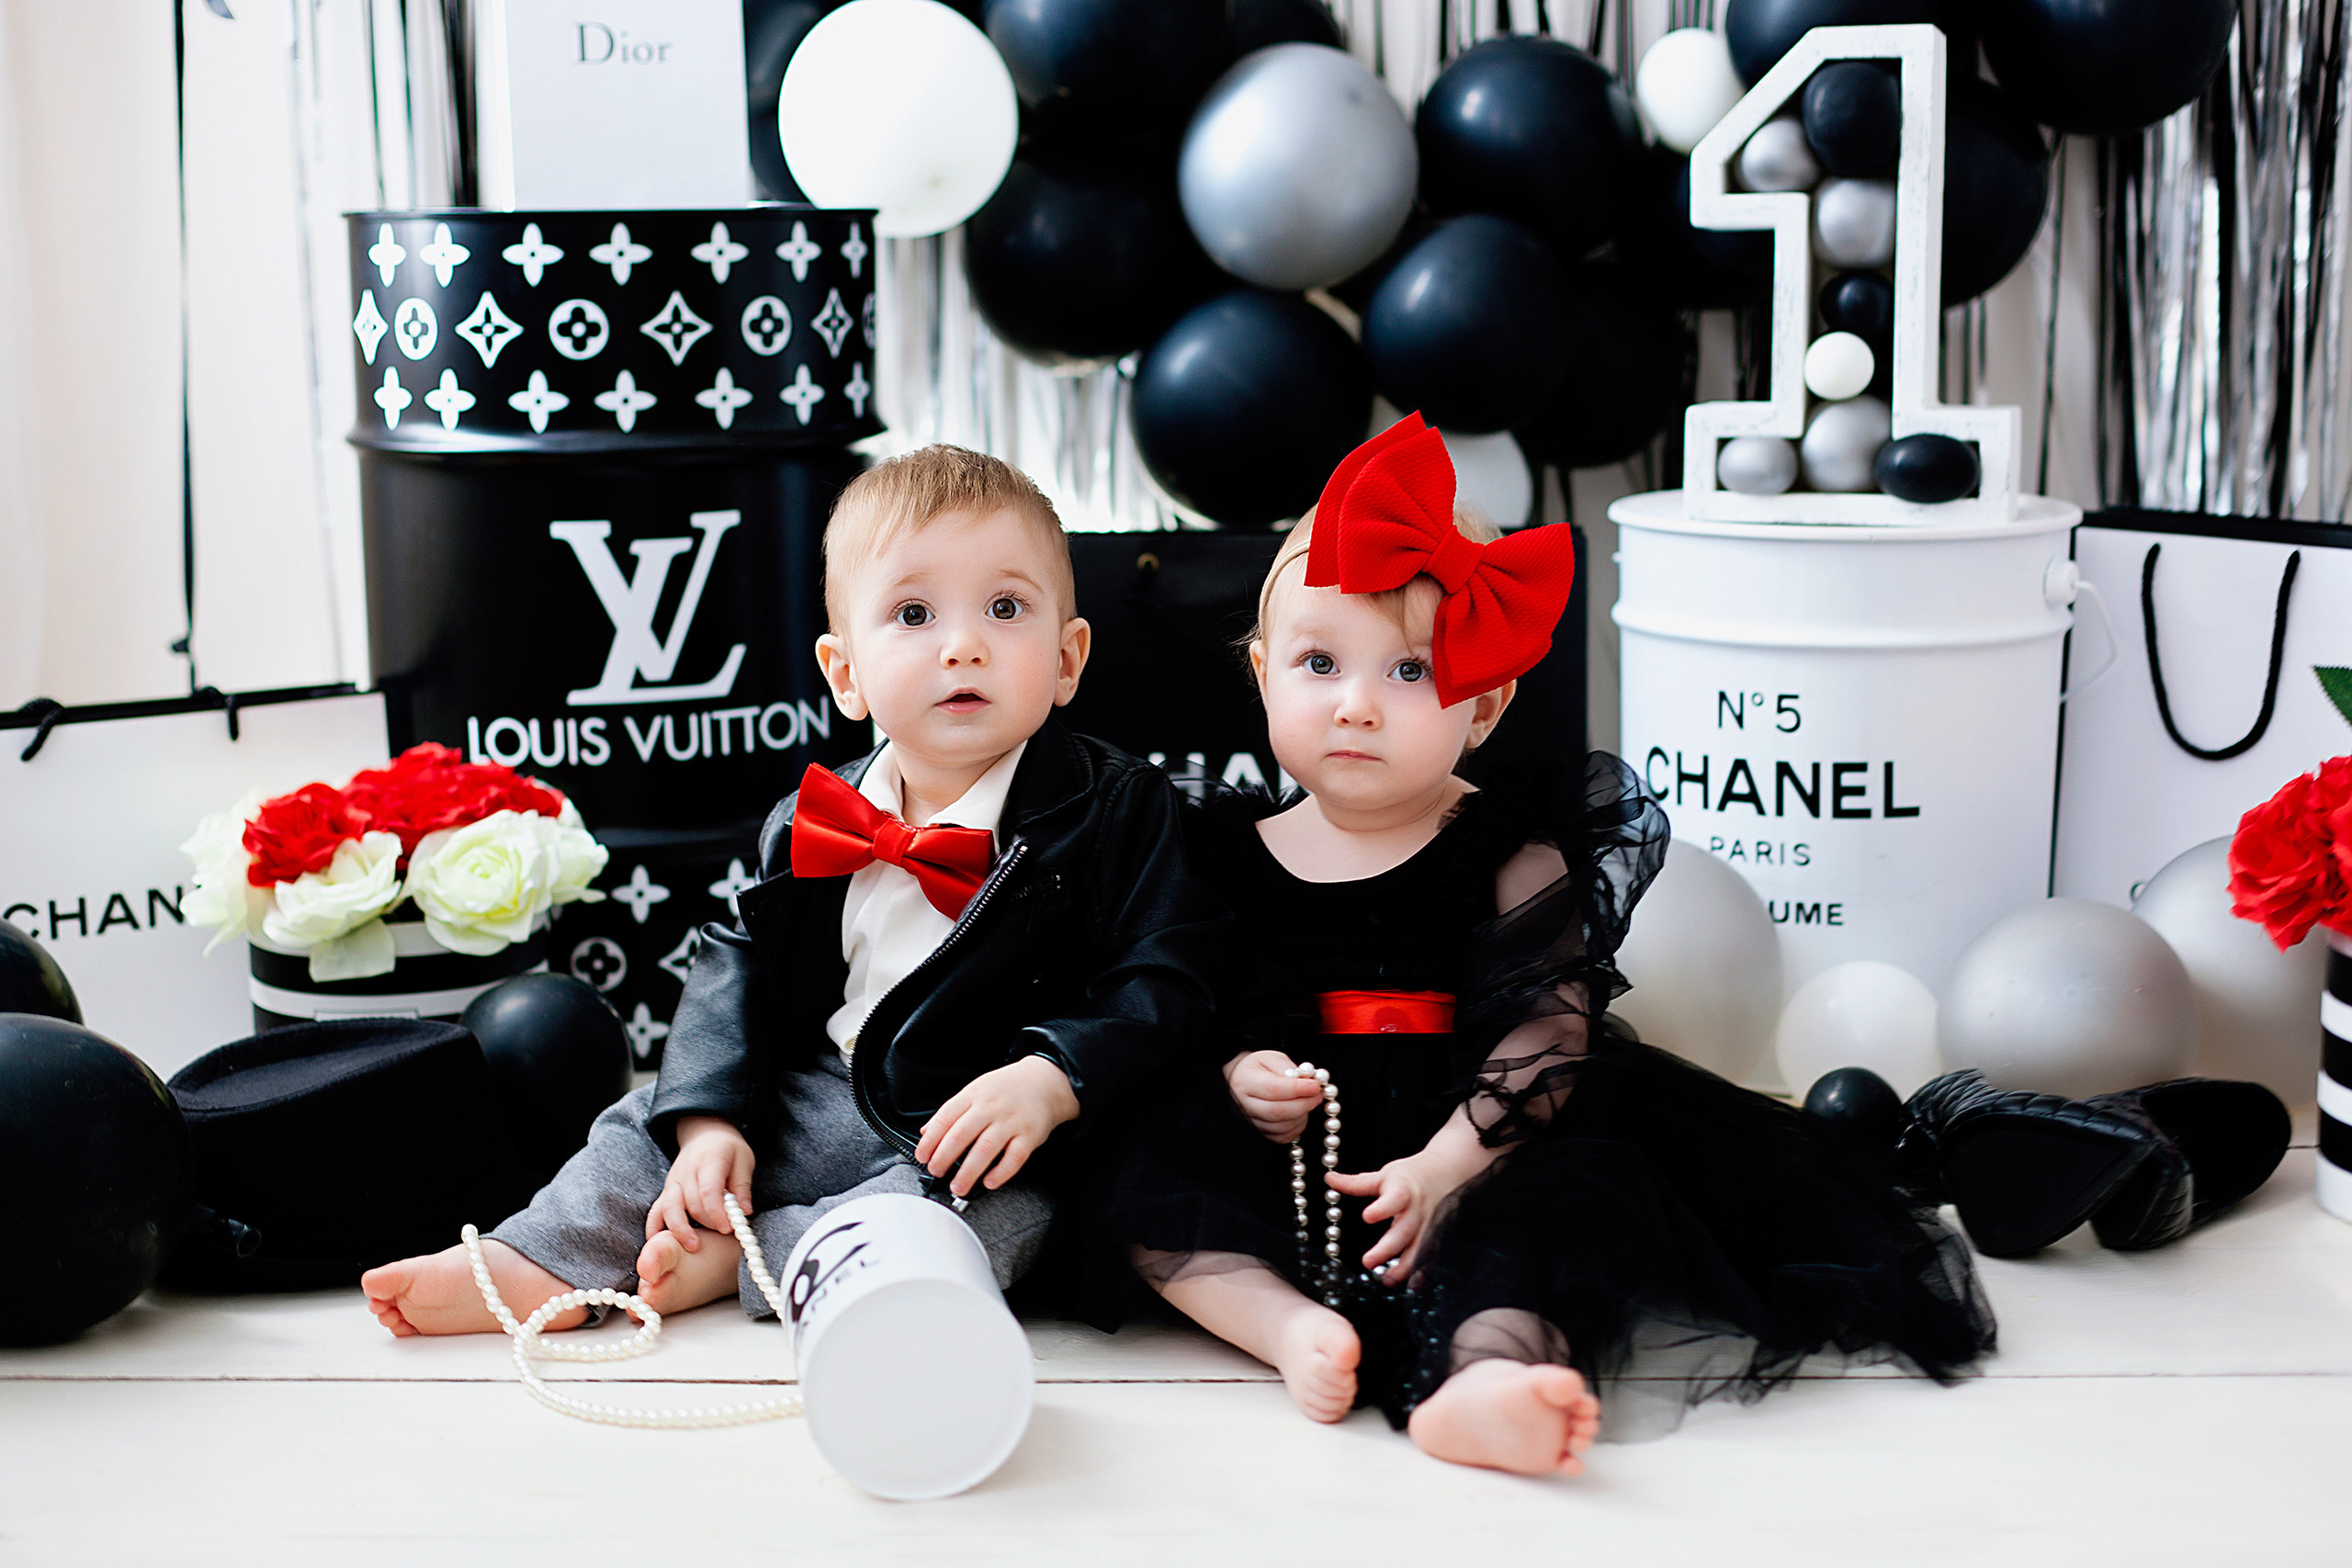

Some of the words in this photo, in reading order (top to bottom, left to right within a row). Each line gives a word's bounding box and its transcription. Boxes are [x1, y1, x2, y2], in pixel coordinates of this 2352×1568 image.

[572, 21, 673, 64] Dior
[1683, 24, 2020, 525] 1
[467, 716, 612, 767] LOUIS
[624, 695, 831, 763] VUITTON
[1645, 746, 1920, 819] CHANEL
[1710, 836, 1812, 866] PARIS
[3, 885, 202, 941] CHAN
[1769, 900, 1844, 925] UME
